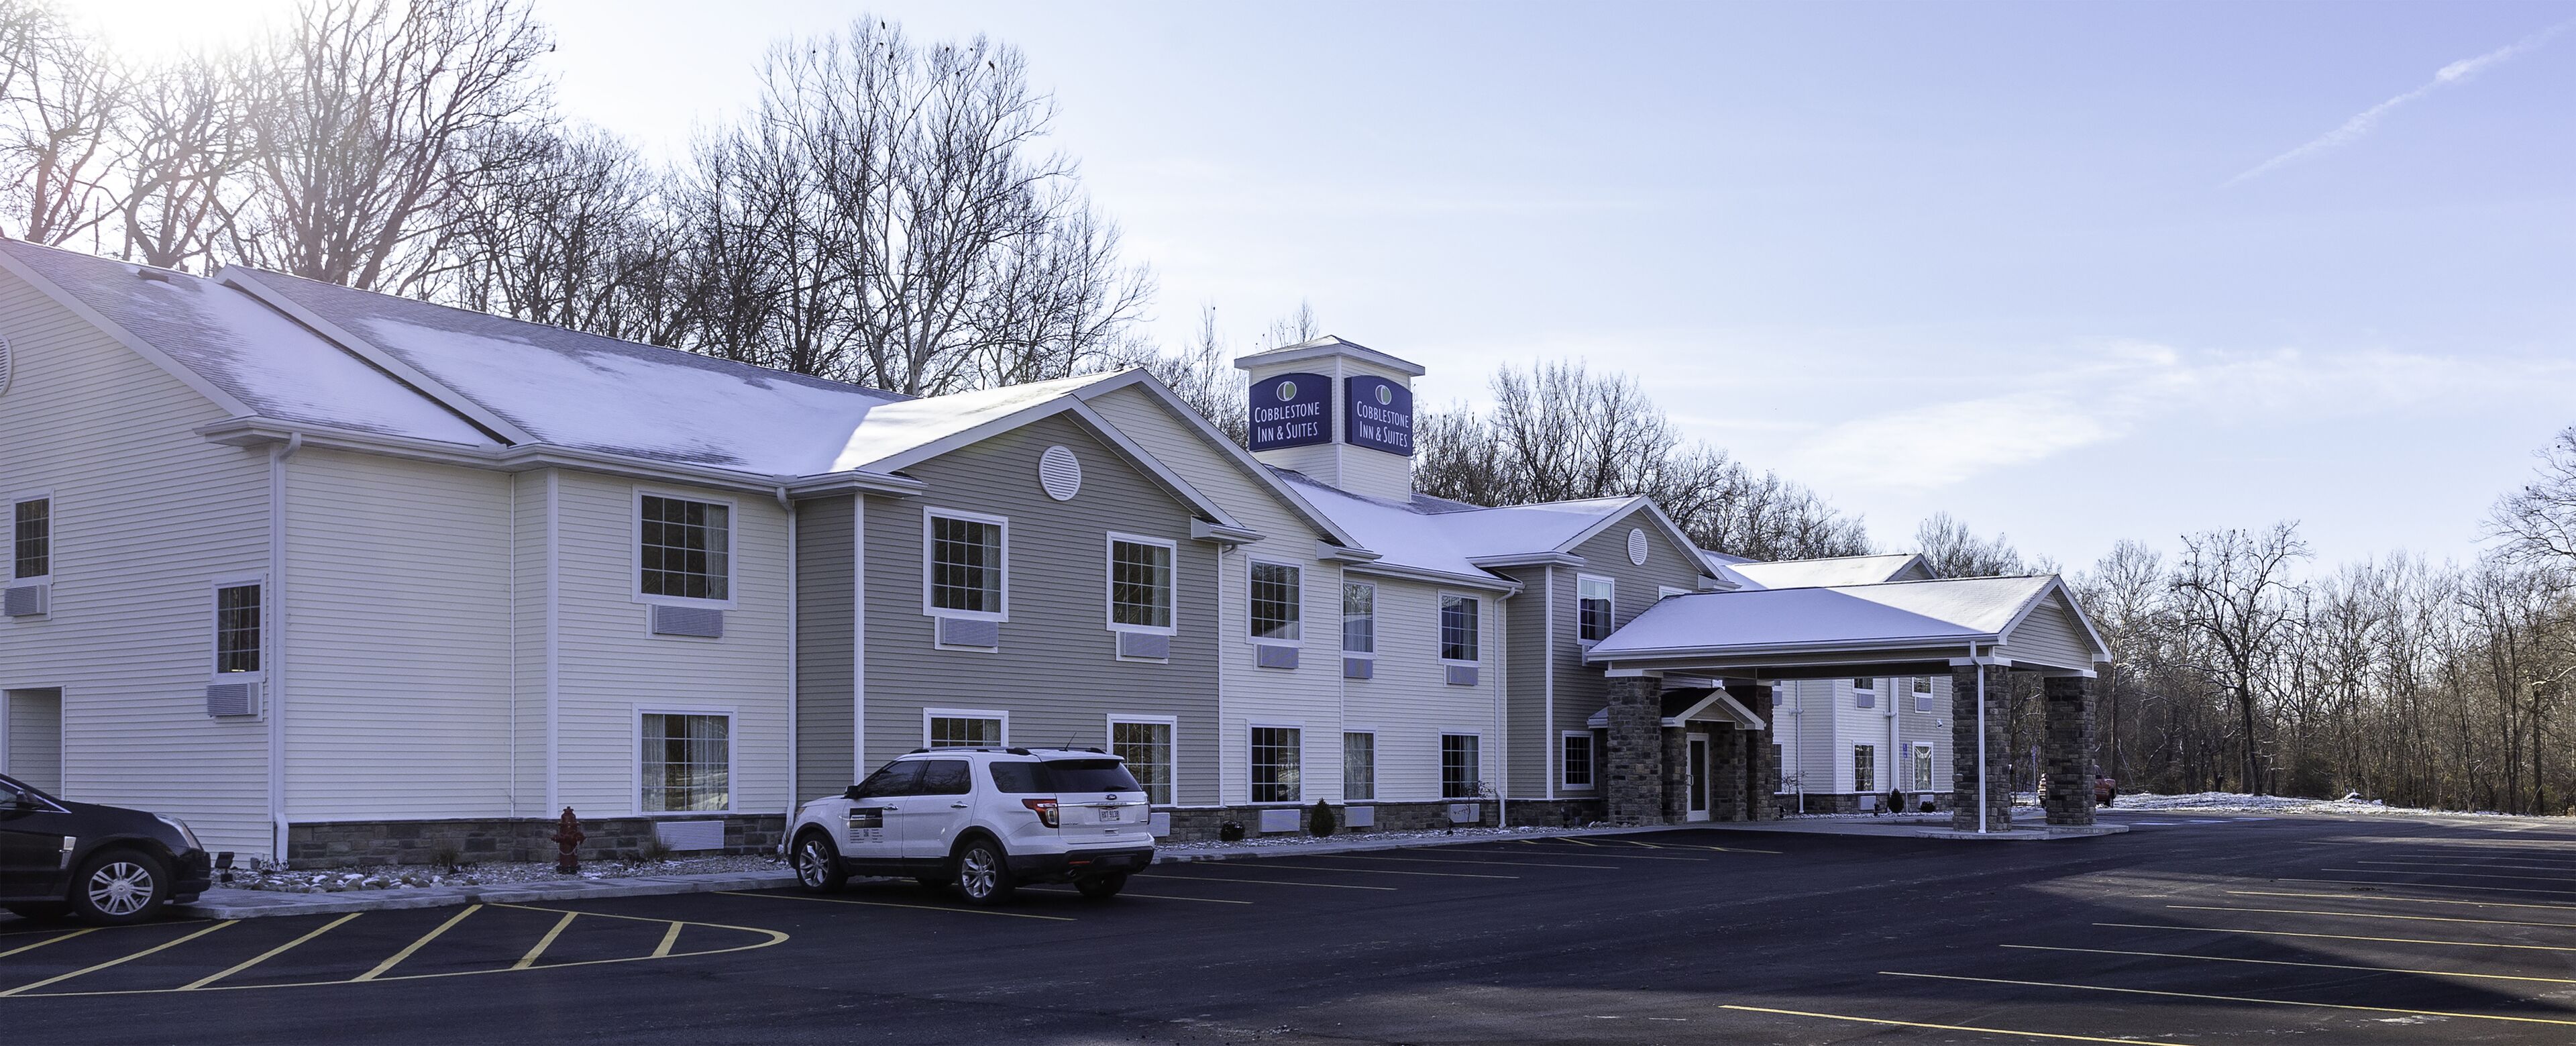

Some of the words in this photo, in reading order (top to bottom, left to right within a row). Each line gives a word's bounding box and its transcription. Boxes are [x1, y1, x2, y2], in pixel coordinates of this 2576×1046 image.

[1254, 402, 1320, 423] COBBLESTONE
[1356, 401, 1409, 428] COBBLESTONE
[1258, 426, 1274, 443] INN
[1277, 422, 1283, 440] &
[1286, 422, 1318, 439] SUITES
[1360, 421, 1373, 439] INN
[1376, 427, 1381, 441] &
[1383, 426, 1407, 448] SUITES
